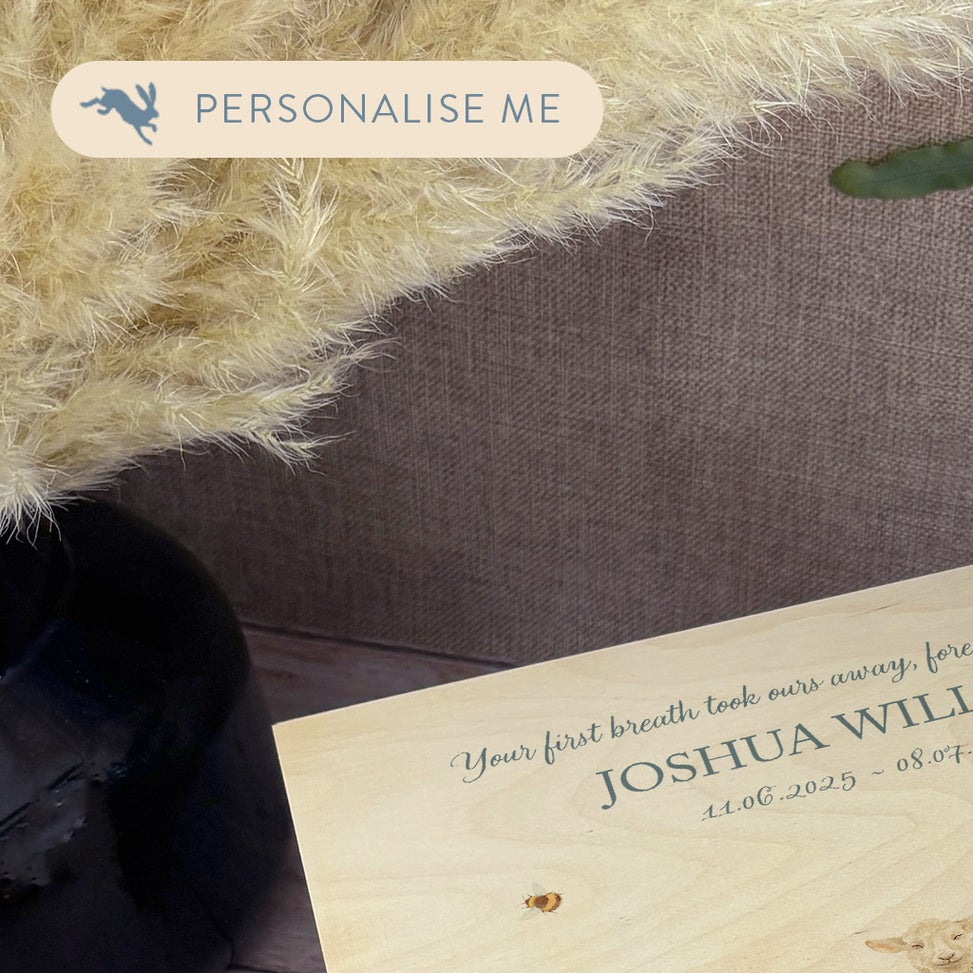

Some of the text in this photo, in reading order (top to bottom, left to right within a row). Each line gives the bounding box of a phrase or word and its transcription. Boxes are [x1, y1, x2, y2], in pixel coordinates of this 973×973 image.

[450, 746, 536, 783] Your
[544, 722, 603, 765] first
[610, 700, 700, 739] breath
[704, 685, 761, 716] took
[768, 677, 824, 701] ours
[830, 657, 918, 686] away,
[595, 722, 831, 810] JOSHUA
[701, 770, 858, 821] 11.06.2025
